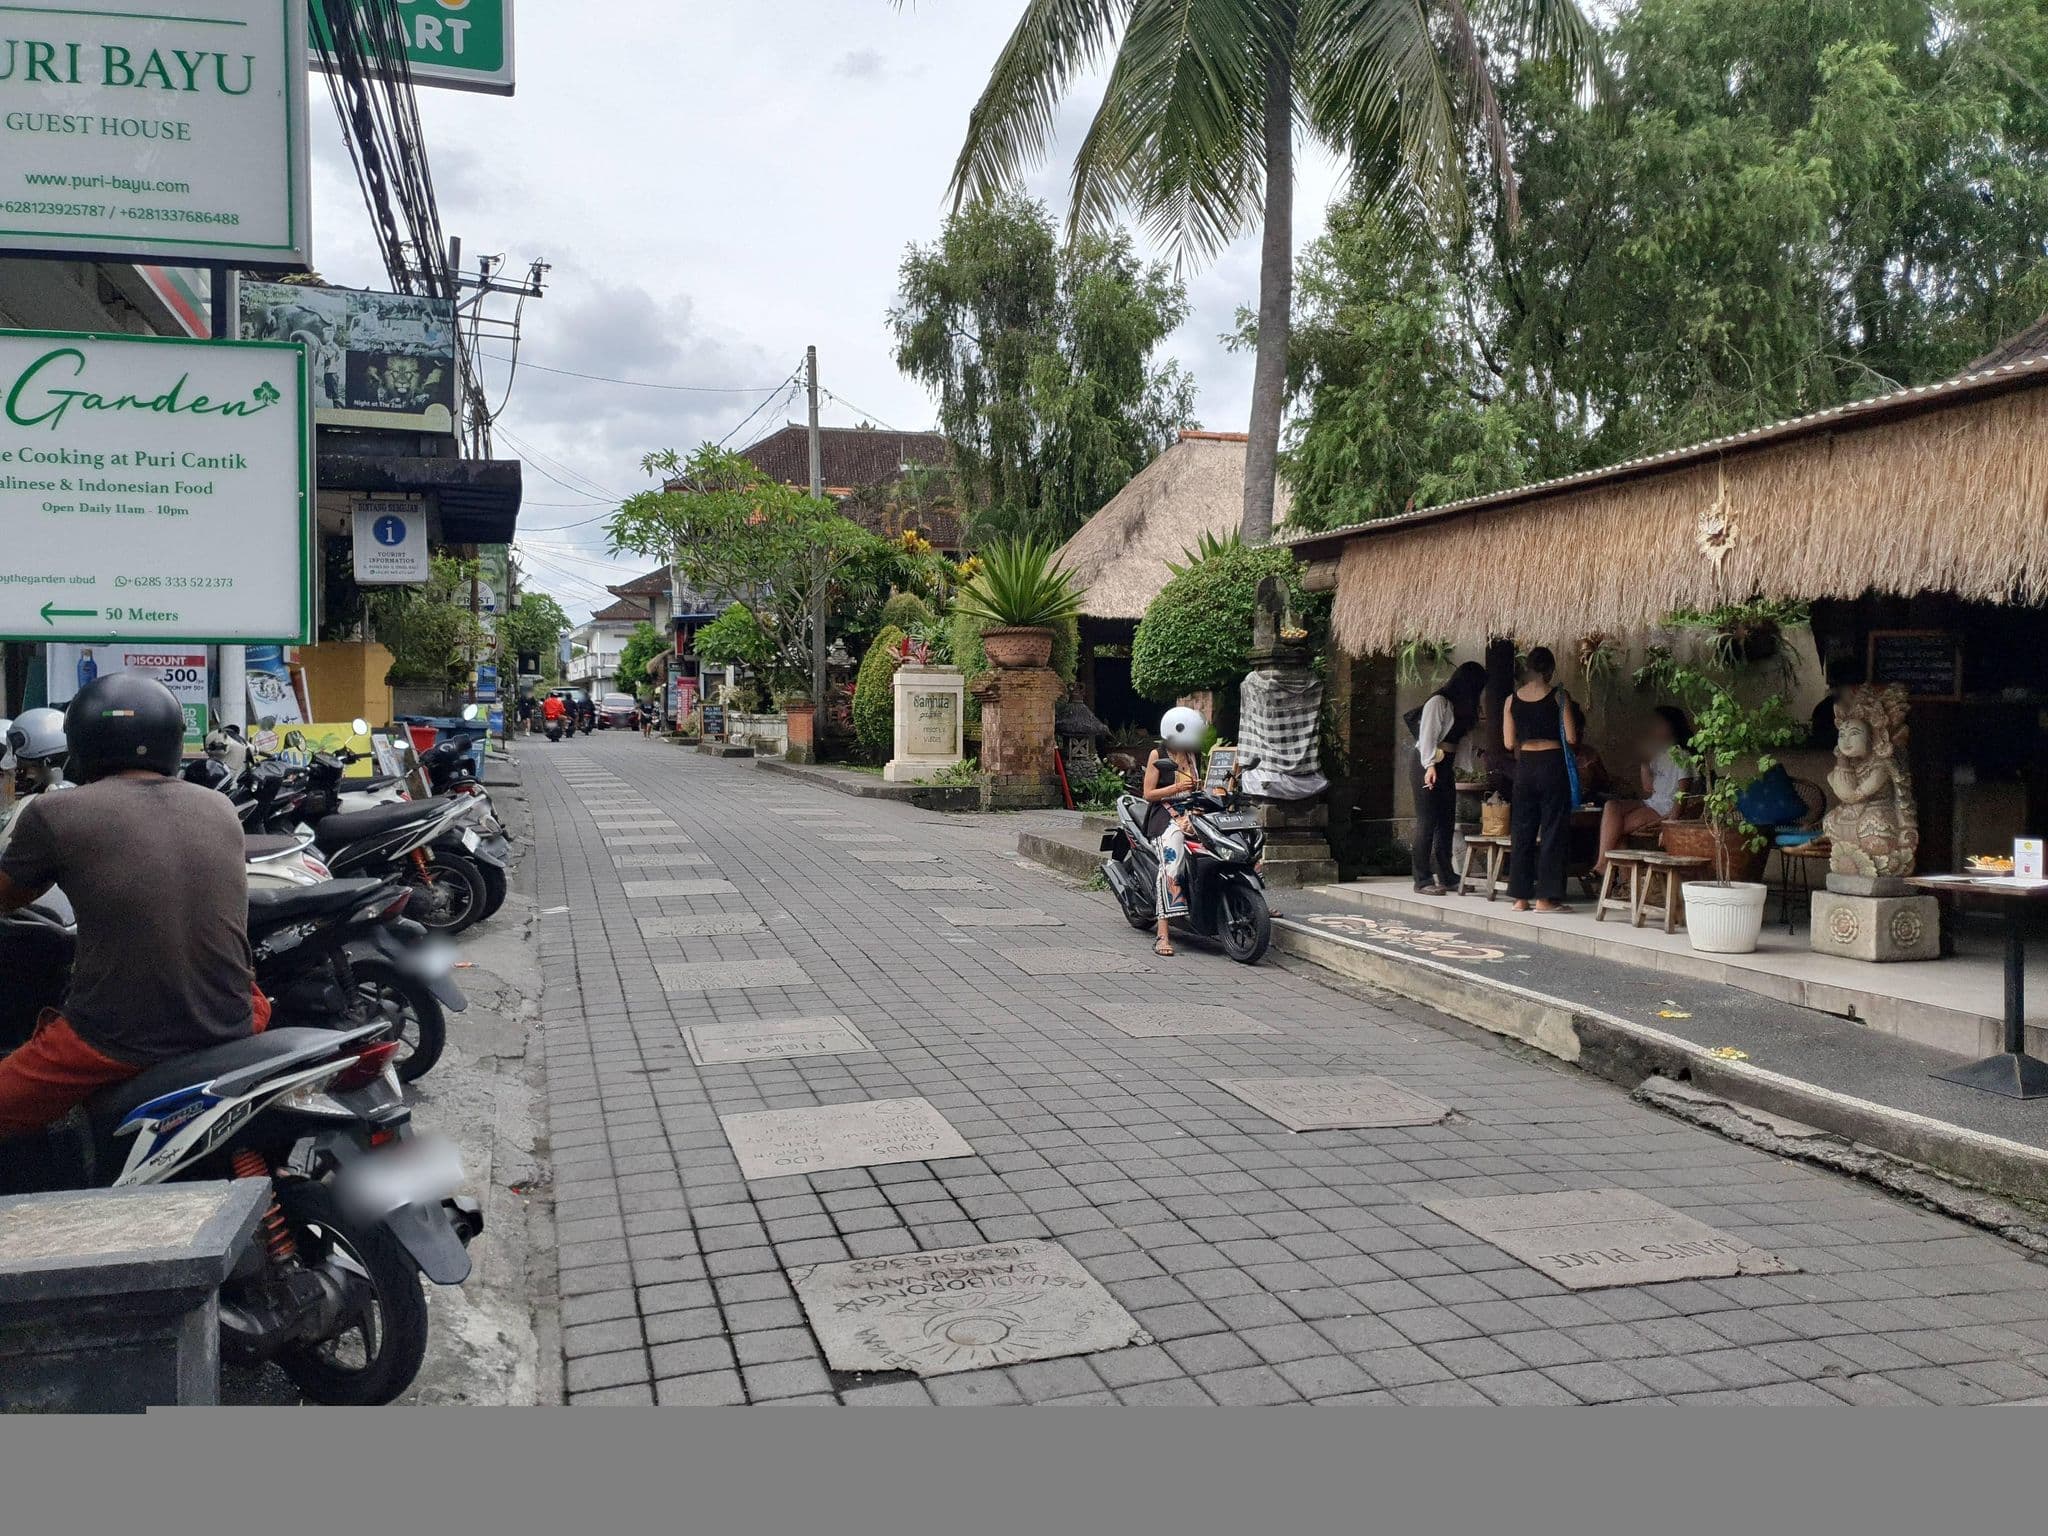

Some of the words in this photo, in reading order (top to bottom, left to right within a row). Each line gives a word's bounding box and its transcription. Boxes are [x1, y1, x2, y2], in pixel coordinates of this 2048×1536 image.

[100, 45, 256, 96] BAYU
[6, 112, 94, 135] GUEST
[100, 117, 192, 141] HOUSE
[25, 174, 190, 194] www.puri-bayu.com
[119, 208, 240, 225] +6281337686488
[5, 348, 268, 431] Garden
[18, 447, 105, 470] Cooking
[110, 454, 129, 466] at
[135, 451, 175, 468] Puri
[181, 452, 248, 469] Cantik
[60, 479, 73, 491] &
[78, 479, 169, 494] Indonesian
[175, 481, 213, 494] Food
[42, 502, 74, 514] Open
[79, 503, 112, 515] Daily
[156, 505, 189, 516] 10pm
[105, 608, 123, 621] 50
[127, 608, 179, 621] Meters
[127, 656, 187, 666] DISCOUNT
[1537, 1248, 1637, 1270] PLACE
